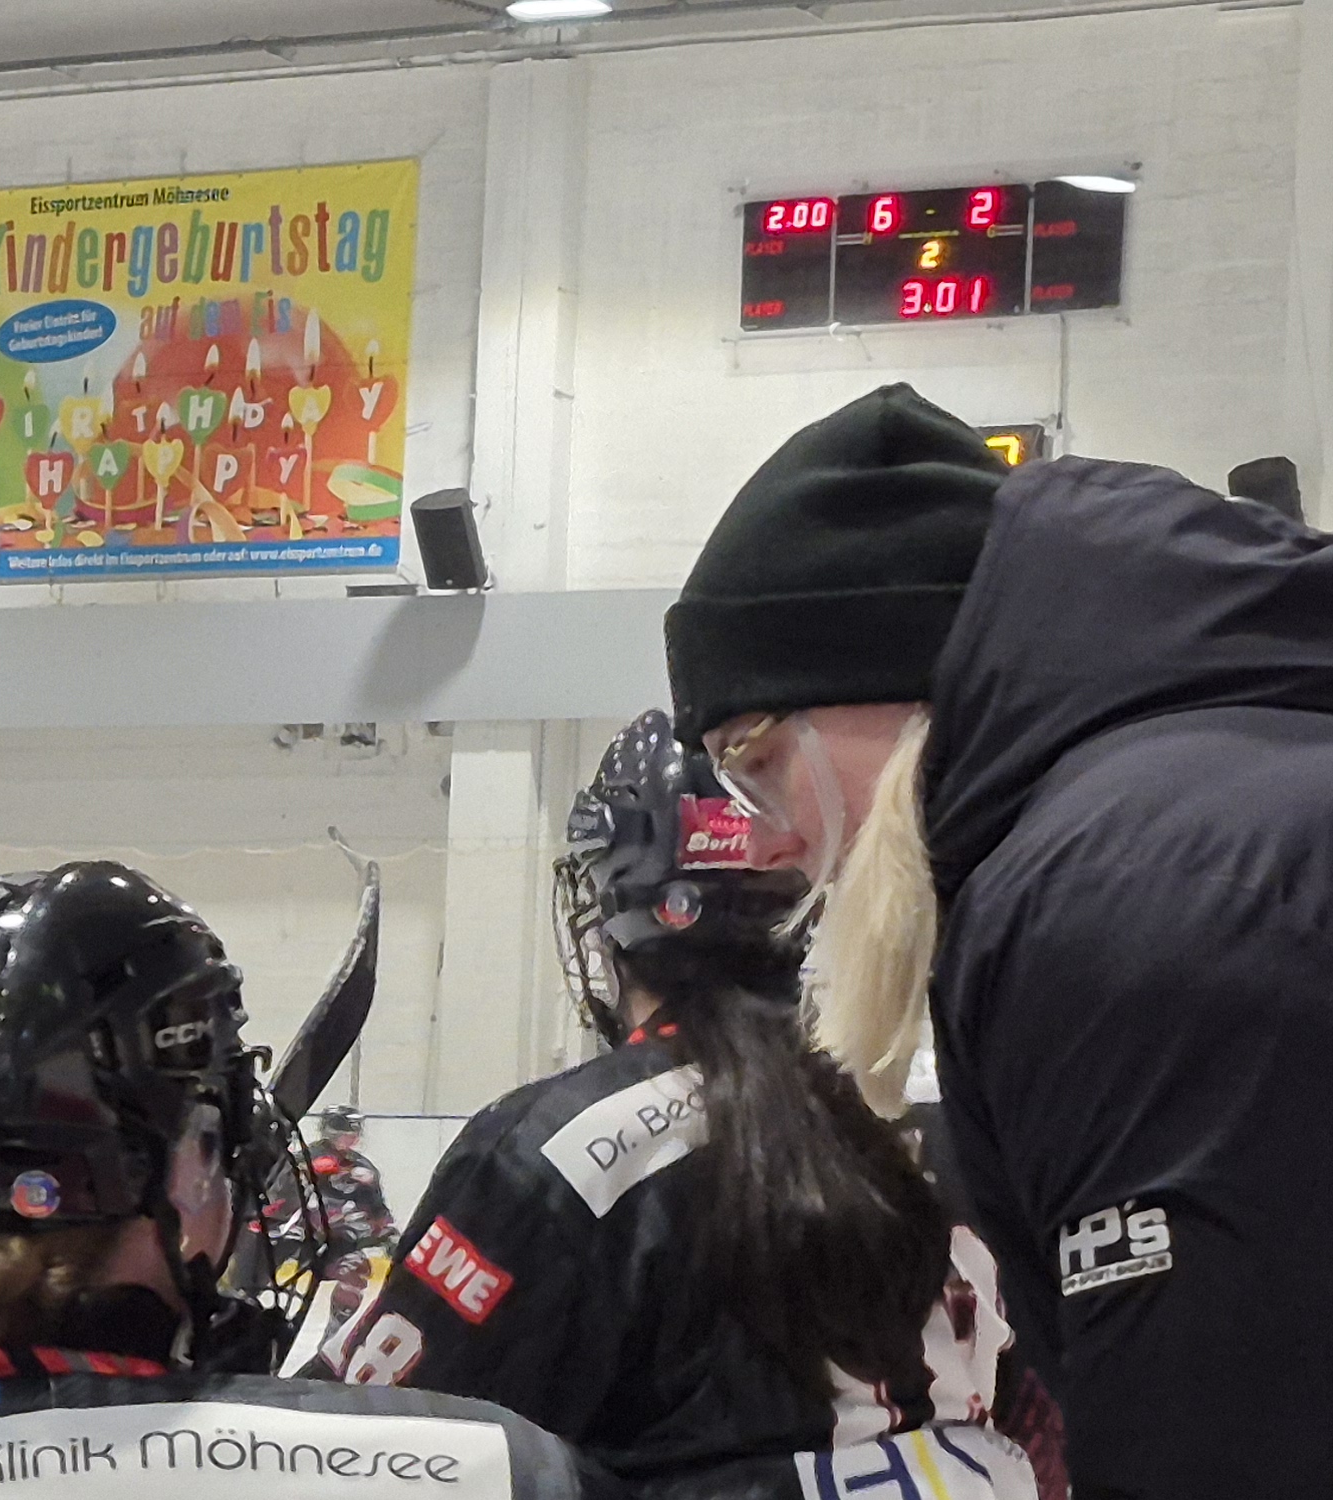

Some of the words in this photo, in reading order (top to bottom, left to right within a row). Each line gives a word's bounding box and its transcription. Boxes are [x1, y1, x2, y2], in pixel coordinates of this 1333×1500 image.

[30, 191, 148, 216] Eissportzentrum
[153, 185, 229, 207] Möhnesee
[768, 202, 828, 230] 2.00
[872, 196, 895, 231] 6
[970, 190, 998, 224] 2
[920, 240, 942, 269] 2
[139, 296, 180, 342] auf
[251, 289, 291, 337] Eis
[900, 278, 985, 315] 3.01
[154, 1017, 215, 1049] CCM
[586, 1128, 637, 1171] Dr.
[139, 1427, 461, 1484] Möhnesee
